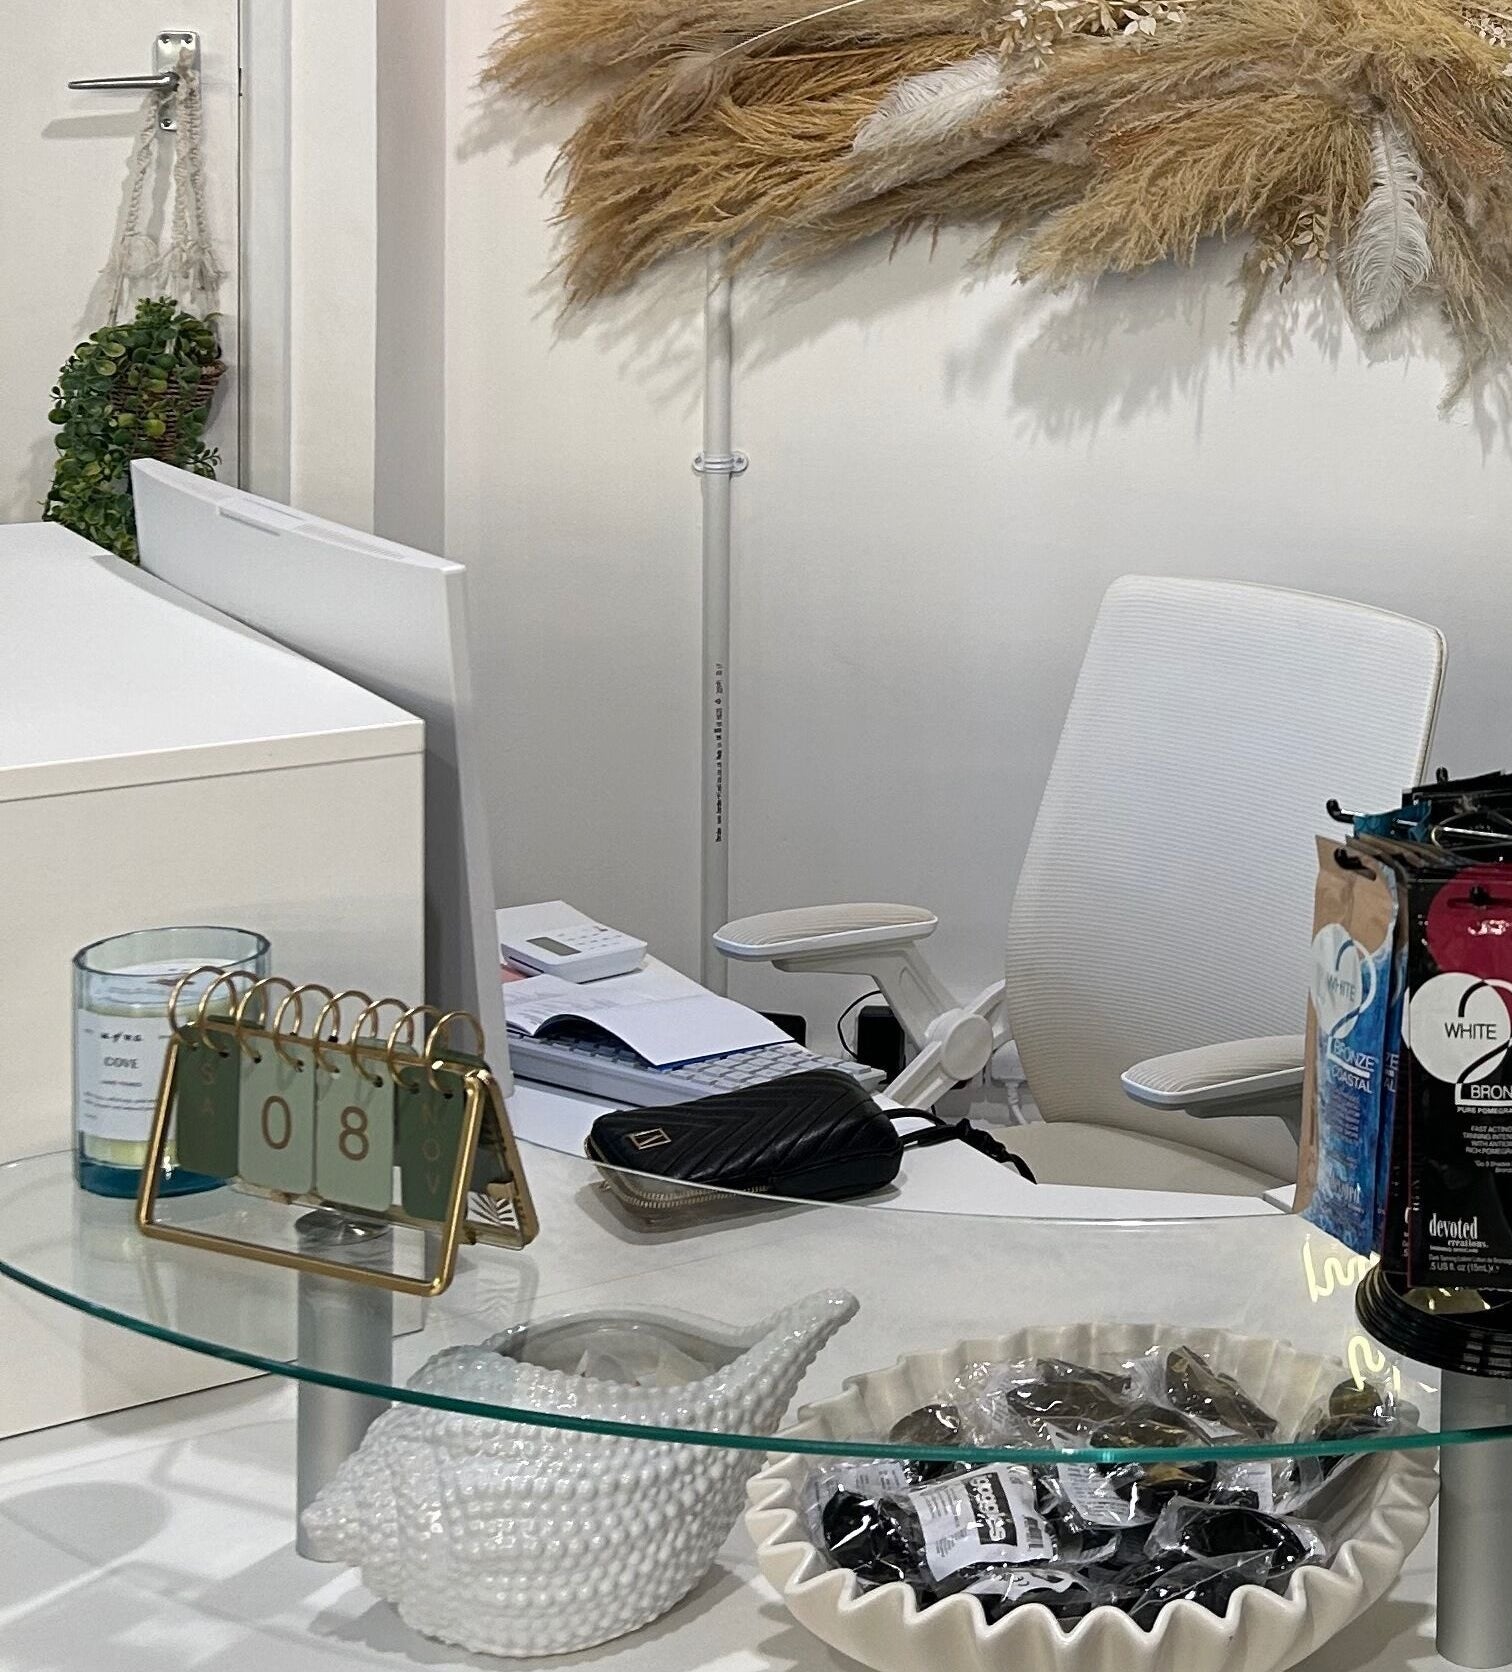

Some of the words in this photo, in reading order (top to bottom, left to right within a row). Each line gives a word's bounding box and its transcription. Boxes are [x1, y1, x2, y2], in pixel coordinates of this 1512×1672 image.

[1327, 975, 1356, 1002] WHITE
[1444, 1022, 1497, 1040] WHITE
[1333, 1039, 1375, 1072] BRONZE
[1429, 1212, 1477, 1239] devoted
